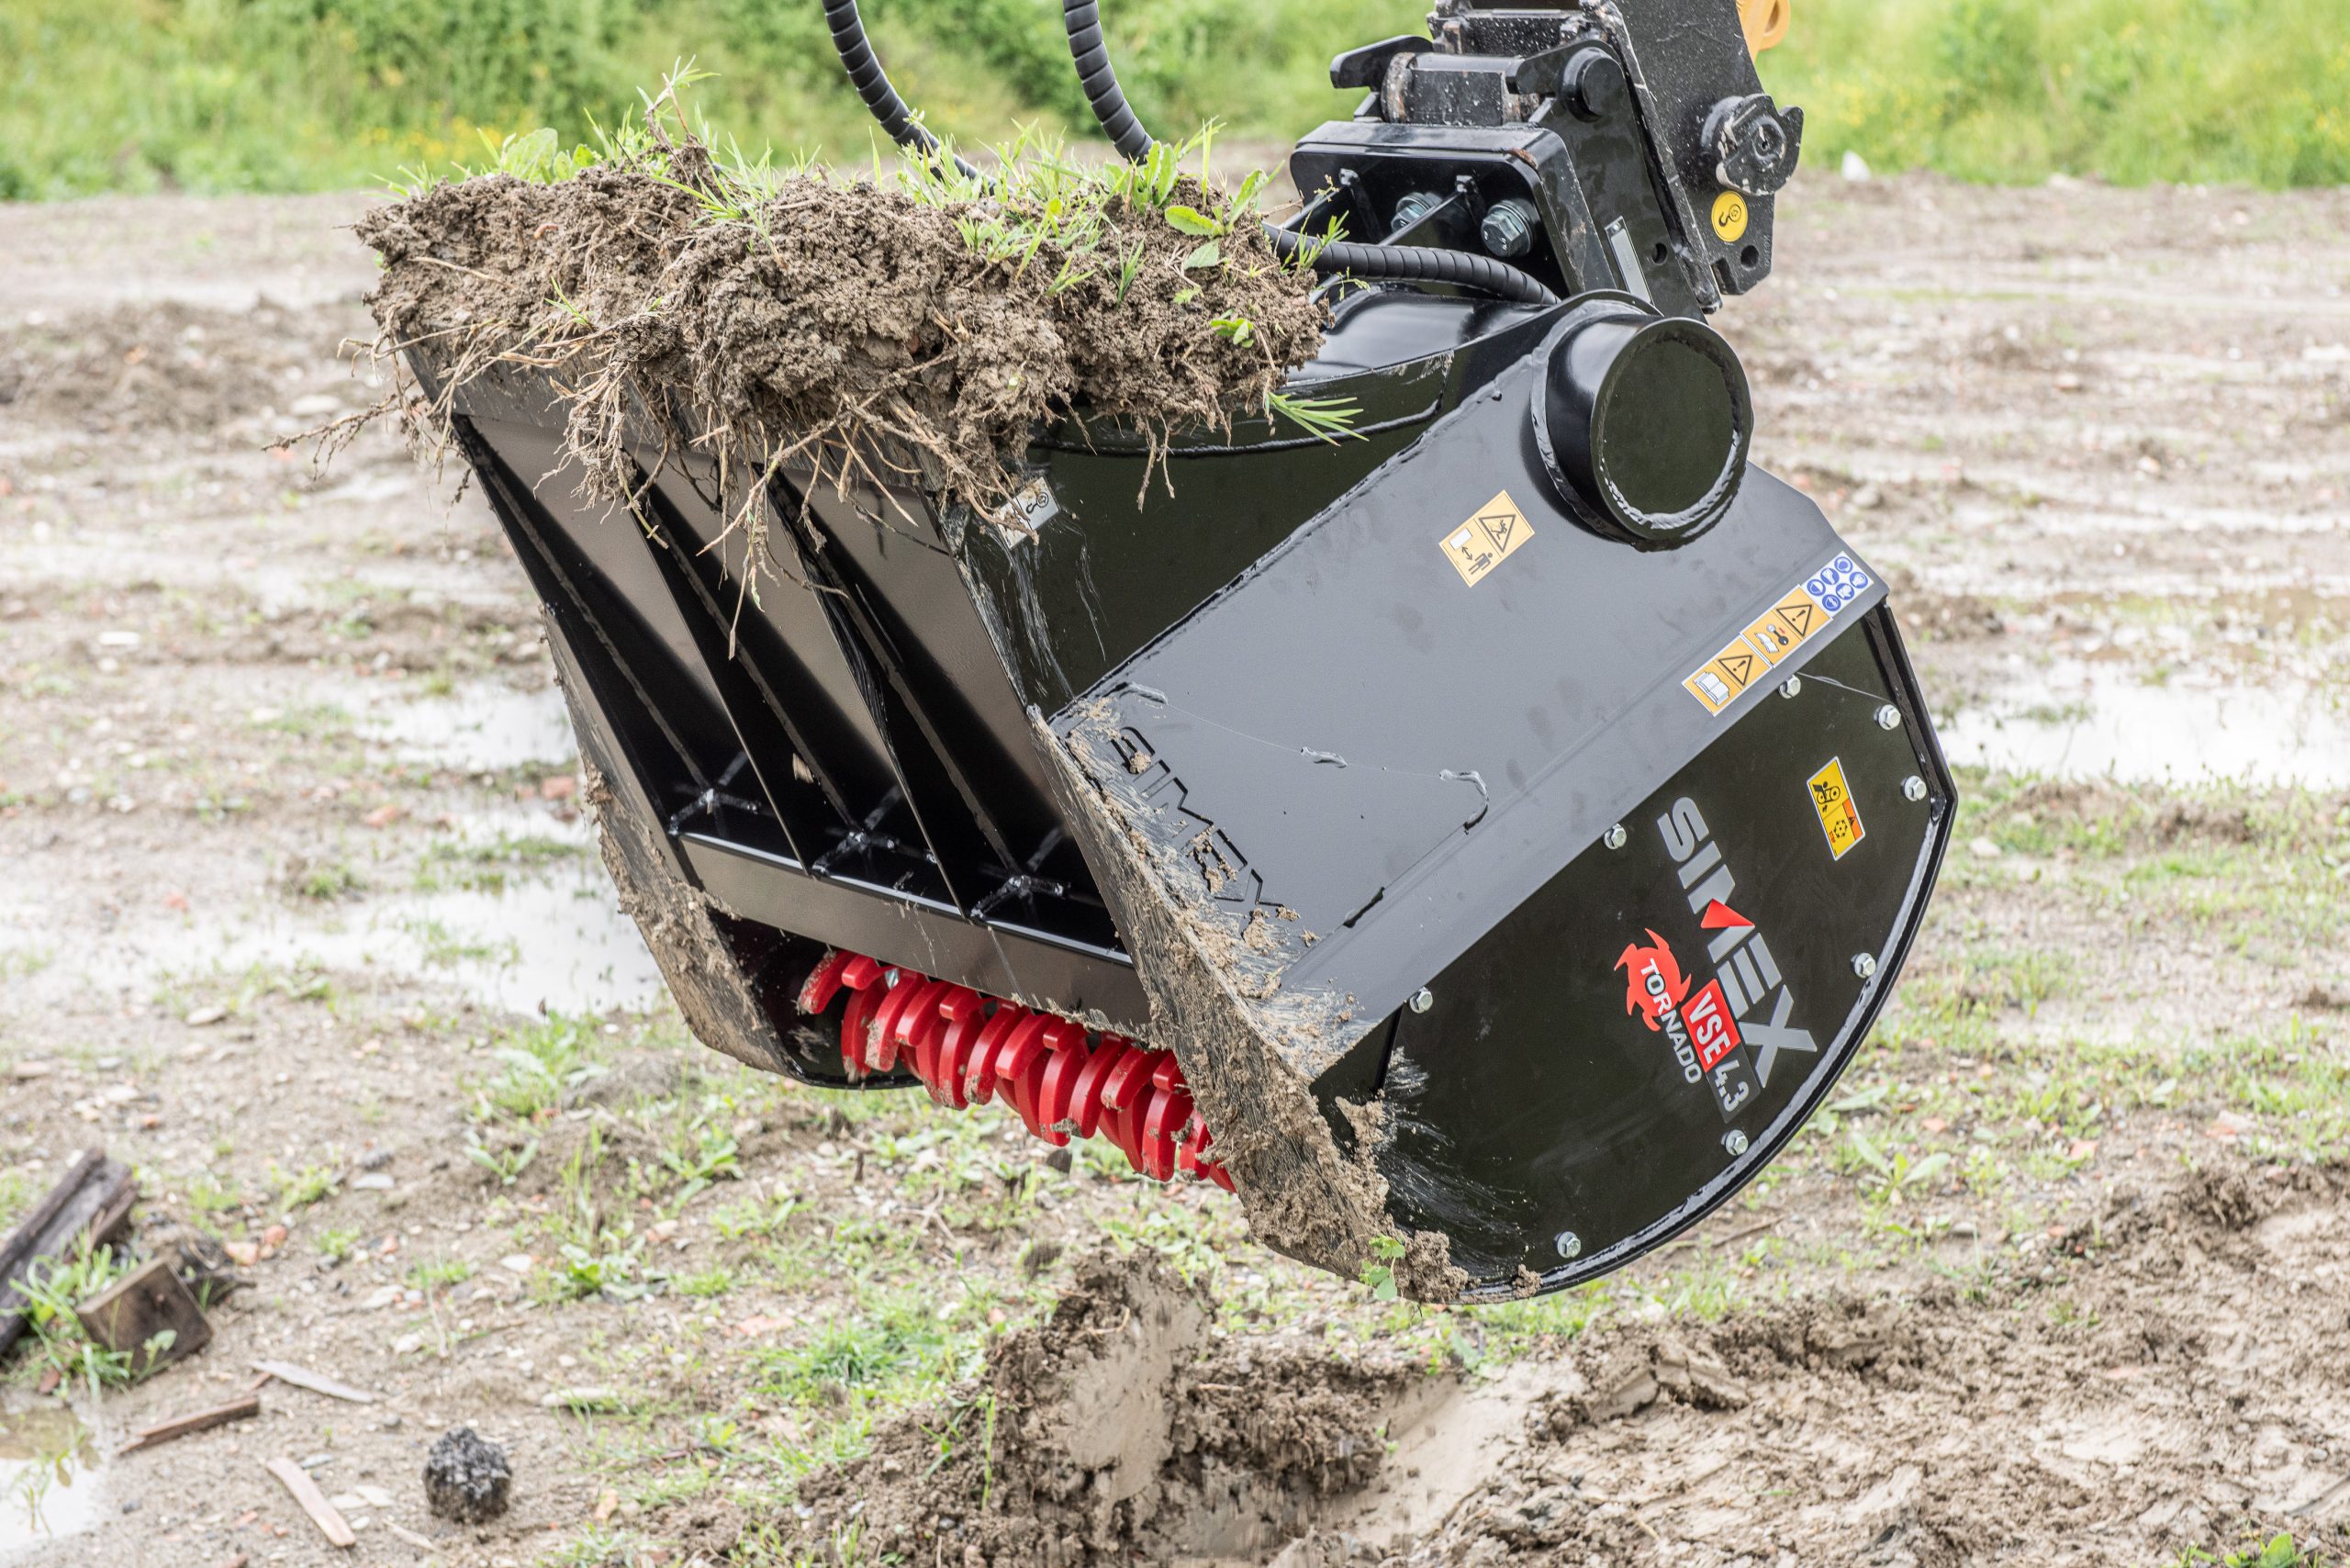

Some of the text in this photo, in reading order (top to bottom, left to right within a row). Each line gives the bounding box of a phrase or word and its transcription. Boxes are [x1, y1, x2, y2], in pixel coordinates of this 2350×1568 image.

[1657, 797, 1818, 1088] SIMEX
[1640, 958, 1702, 1084] TORNADO
[1688, 990, 1750, 1113] VSE 4.3
